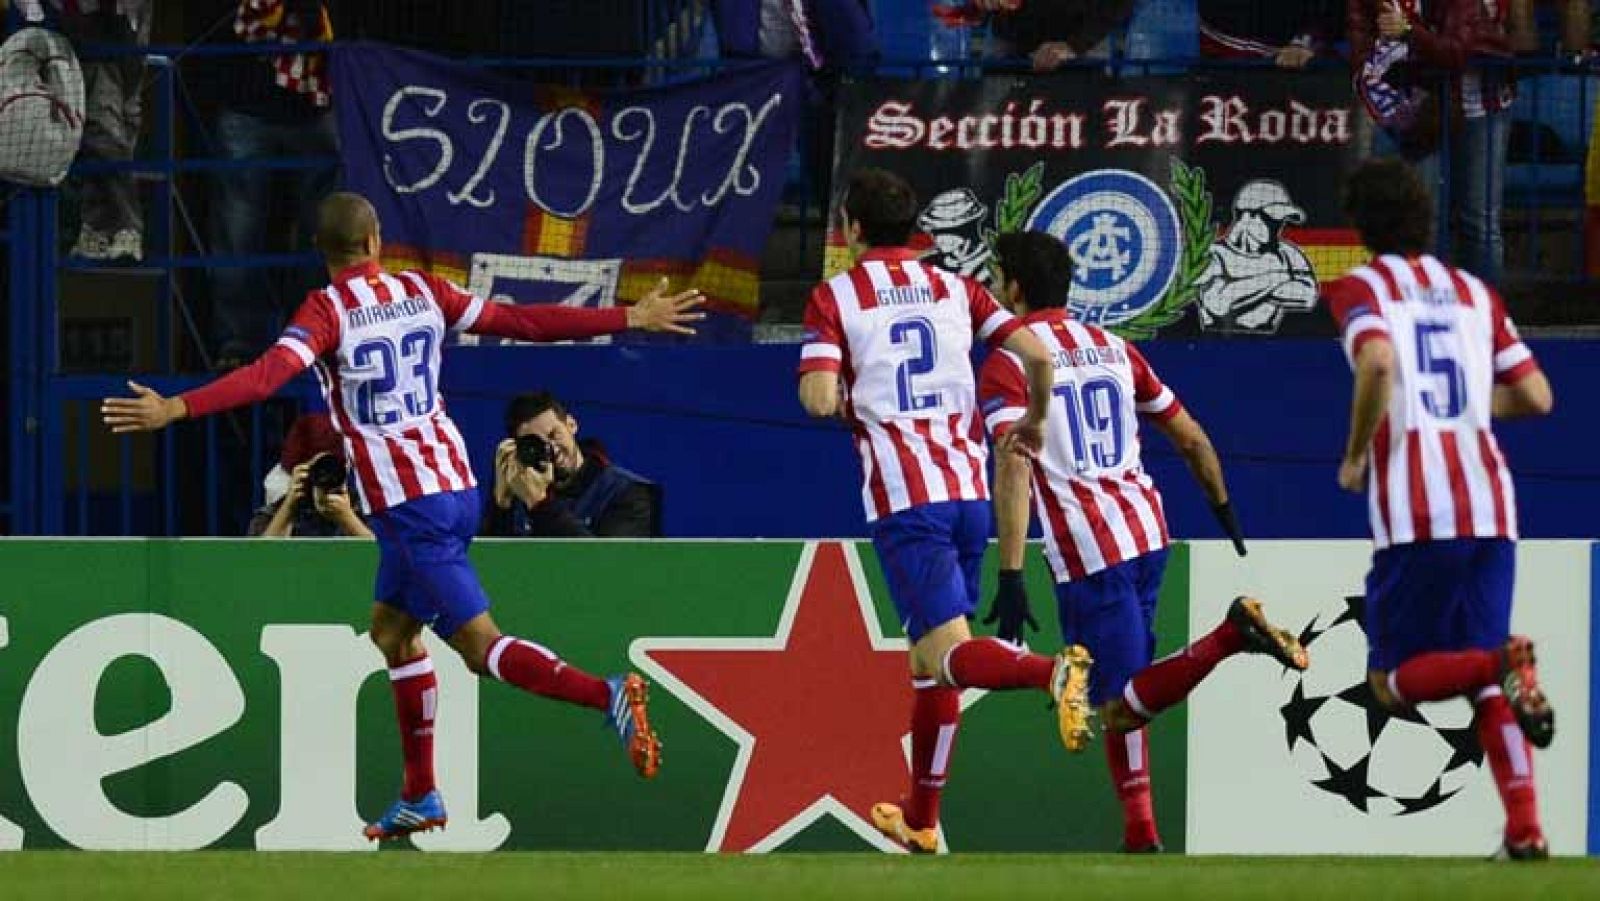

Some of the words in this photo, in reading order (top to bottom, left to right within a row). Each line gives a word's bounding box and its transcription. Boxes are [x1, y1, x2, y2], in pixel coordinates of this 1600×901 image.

[864, 99, 1086, 150] Sección
[1103, 98, 1181, 147] La
[1198, 94, 1350, 144] Roda
[352, 325, 437, 426] 23
[889, 314, 942, 412] 2
[1414, 318, 1468, 419] 5
[1052, 374, 1124, 474] 19
[0, 612, 512, 852] en
